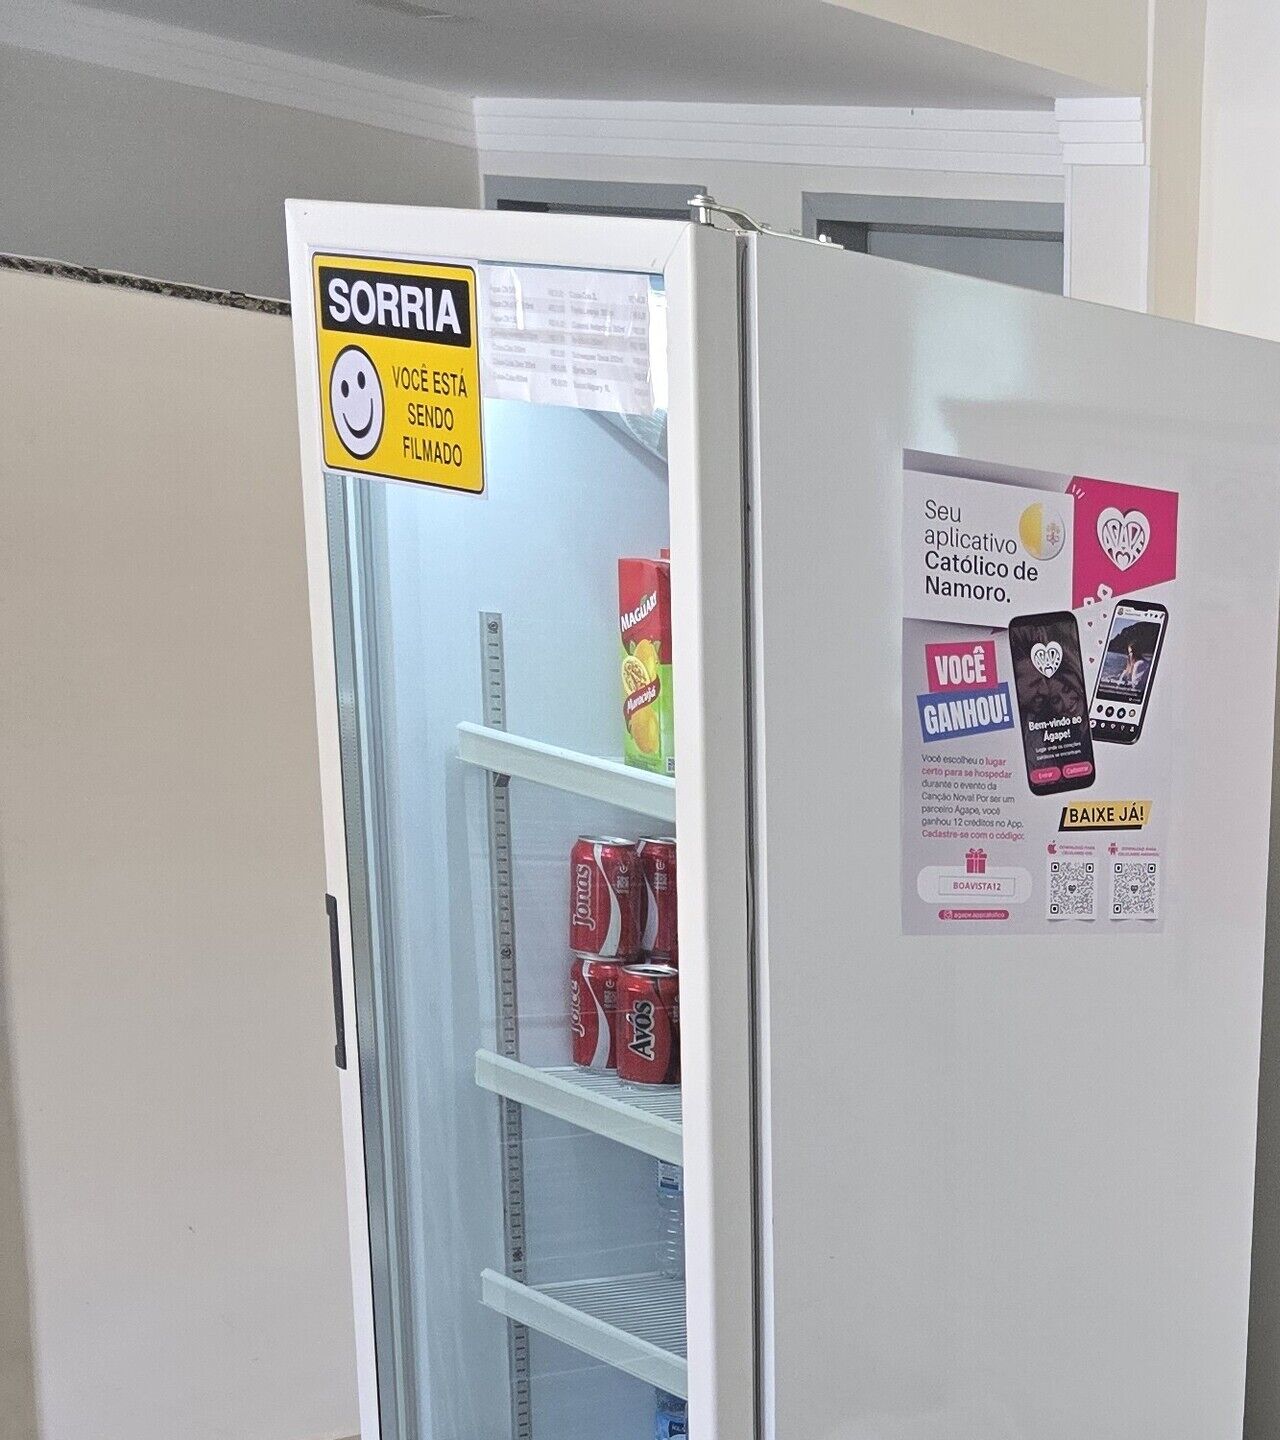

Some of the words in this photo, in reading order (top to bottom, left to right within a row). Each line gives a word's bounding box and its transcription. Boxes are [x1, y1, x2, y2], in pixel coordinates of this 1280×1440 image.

[328, 277, 461, 334] SORRIA
[392, 363, 429, 392] VOCÊ
[433, 367, 468, 398] ESTÁ
[407, 403, 454, 431] SENDO
[402, 436, 463, 467] FILMADO
[925, 499, 961, 523] Seu
[925, 529, 1017, 555] aplicativo
[925, 551, 1009, 578] Católico
[1013, 561, 1038, 581] de
[925, 576, 1011, 603] Namoro.
[934, 645, 987, 686] VOCÊ
[923, 693, 1010, 735] GANHOU!
[1029, 717, 1071, 731] Bem-vindo
[921, 754, 941, 763] Você
[943, 756, 977, 765] escolheu
[985, 757, 1006, 767] lugar
[921, 767, 943, 775] certo
[944, 768, 963, 777] para
[974, 769, 1012, 779] hospedar
[921, 779, 952, 788] durante
[953, 781, 959, 789] o
[960, 781, 986, 789] evento
[987, 782, 997, 790] da
[921, 792, 951, 802] Canção
[976, 794, 988, 803] Por
[921, 806, 953, 814] parceiro
[982, 805, 1001, 815] você
[921, 817, 951, 827] ganhou
[953, 818, 963, 826] 12
[964, 818, 994, 827] créditos
[995, 820, 1005, 828] no
[1069, 807, 1115, 823] BAIXE
[1118, 802, 1144, 821] JÁ!
[922, 829, 969, 839] Cadastre-se
[970, 831, 988, 839] com
[573, 864, 595, 931] Jonas
[953, 881, 1001, 892] BOAVISTA12
[627, 1000, 655, 1062] Avós
